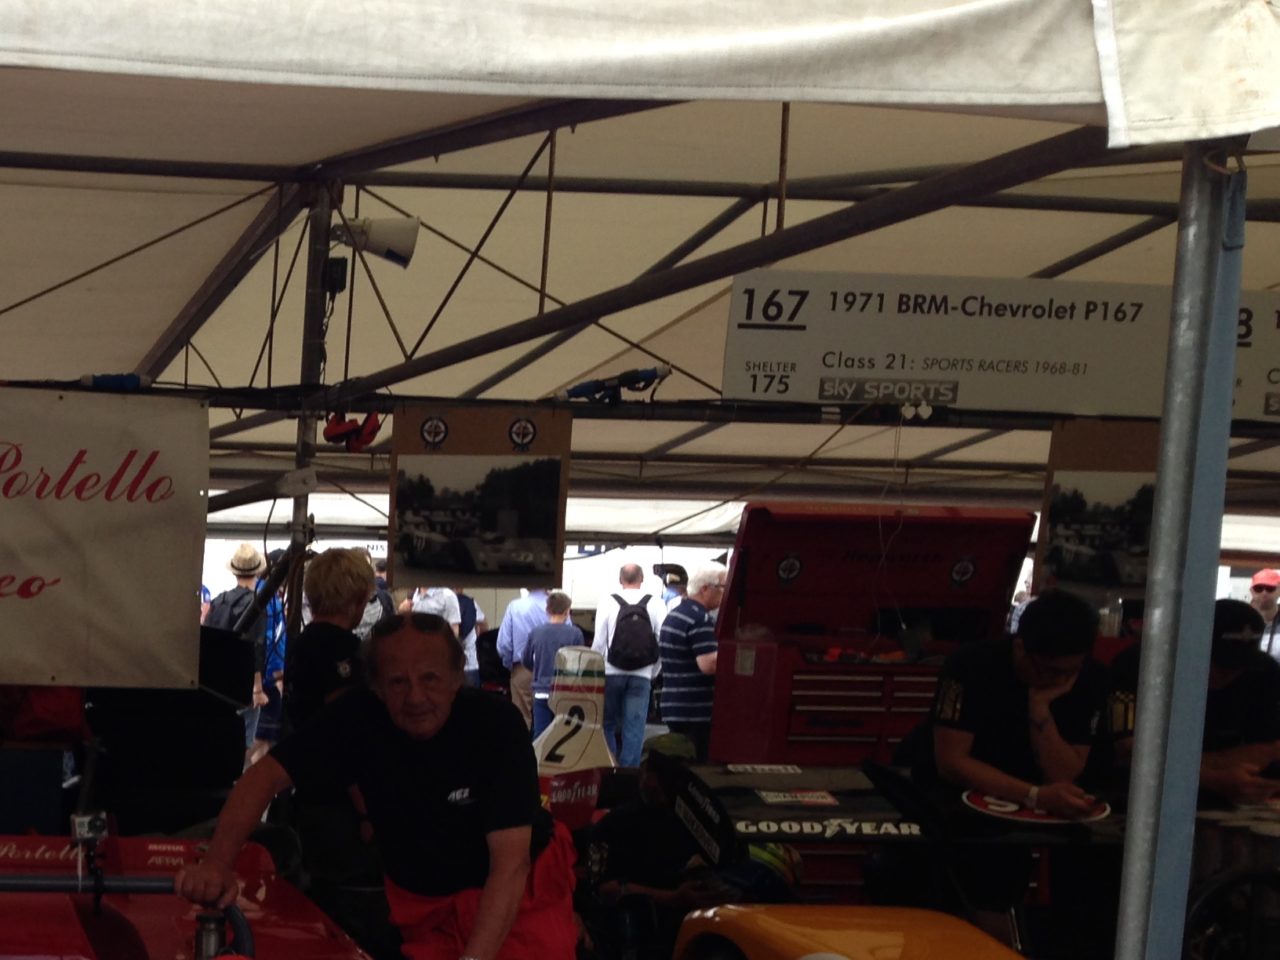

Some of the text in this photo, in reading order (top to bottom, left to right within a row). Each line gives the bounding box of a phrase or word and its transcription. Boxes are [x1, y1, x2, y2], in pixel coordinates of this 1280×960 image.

[742, 289, 809, 322] 167
[829, 292, 1144, 323] 1971 BRM-Chevrolet P167
[744, 360, 797, 374] SHELTER
[821, 351, 1088, 376] Class 21: SPORTS RACERS 1968-81
[749, 374, 790, 394] 175
[822, 379, 953, 402] sky SPORTS
[545, 705, 585, 763] 2
[735, 817, 922, 839] GOODYEAR
